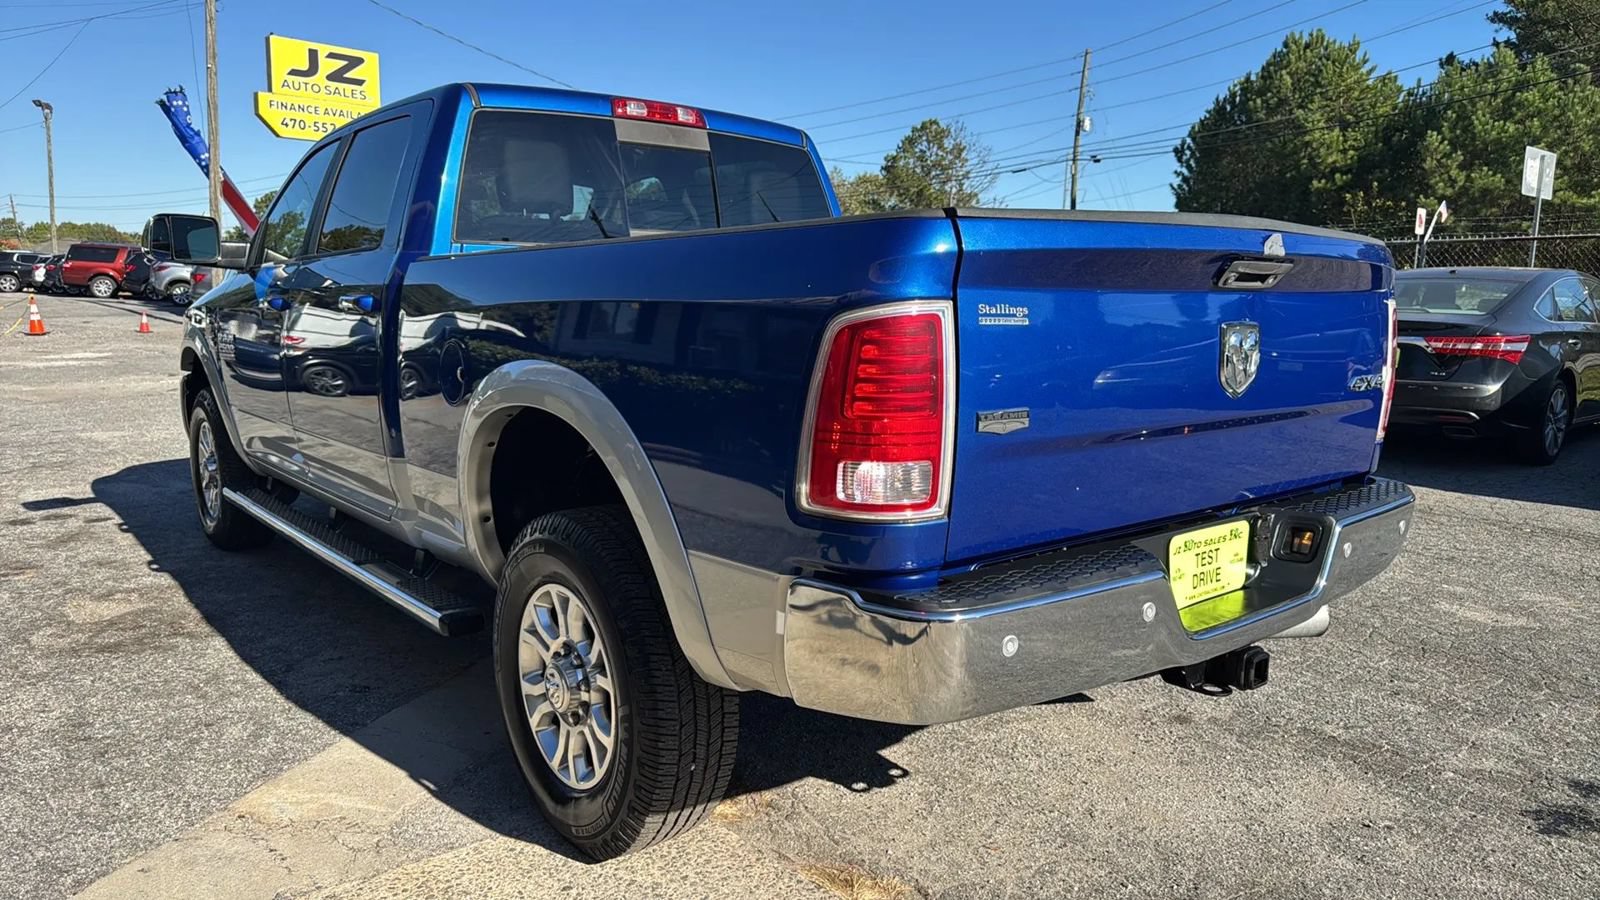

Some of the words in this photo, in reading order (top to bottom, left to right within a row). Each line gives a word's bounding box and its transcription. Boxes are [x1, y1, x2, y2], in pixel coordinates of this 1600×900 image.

[286, 48, 366, 86] JZ
[281, 79, 321, 94] AUTO
[324, 85, 367, 101] SALES
[269, 99, 320, 115] FINANCE
[978, 303, 1029, 318] Stallings
[1203, 534, 1228, 547] SALES
[1195, 547, 1220, 569] TEST
[1192, 566, 1222, 590] DRIVE
